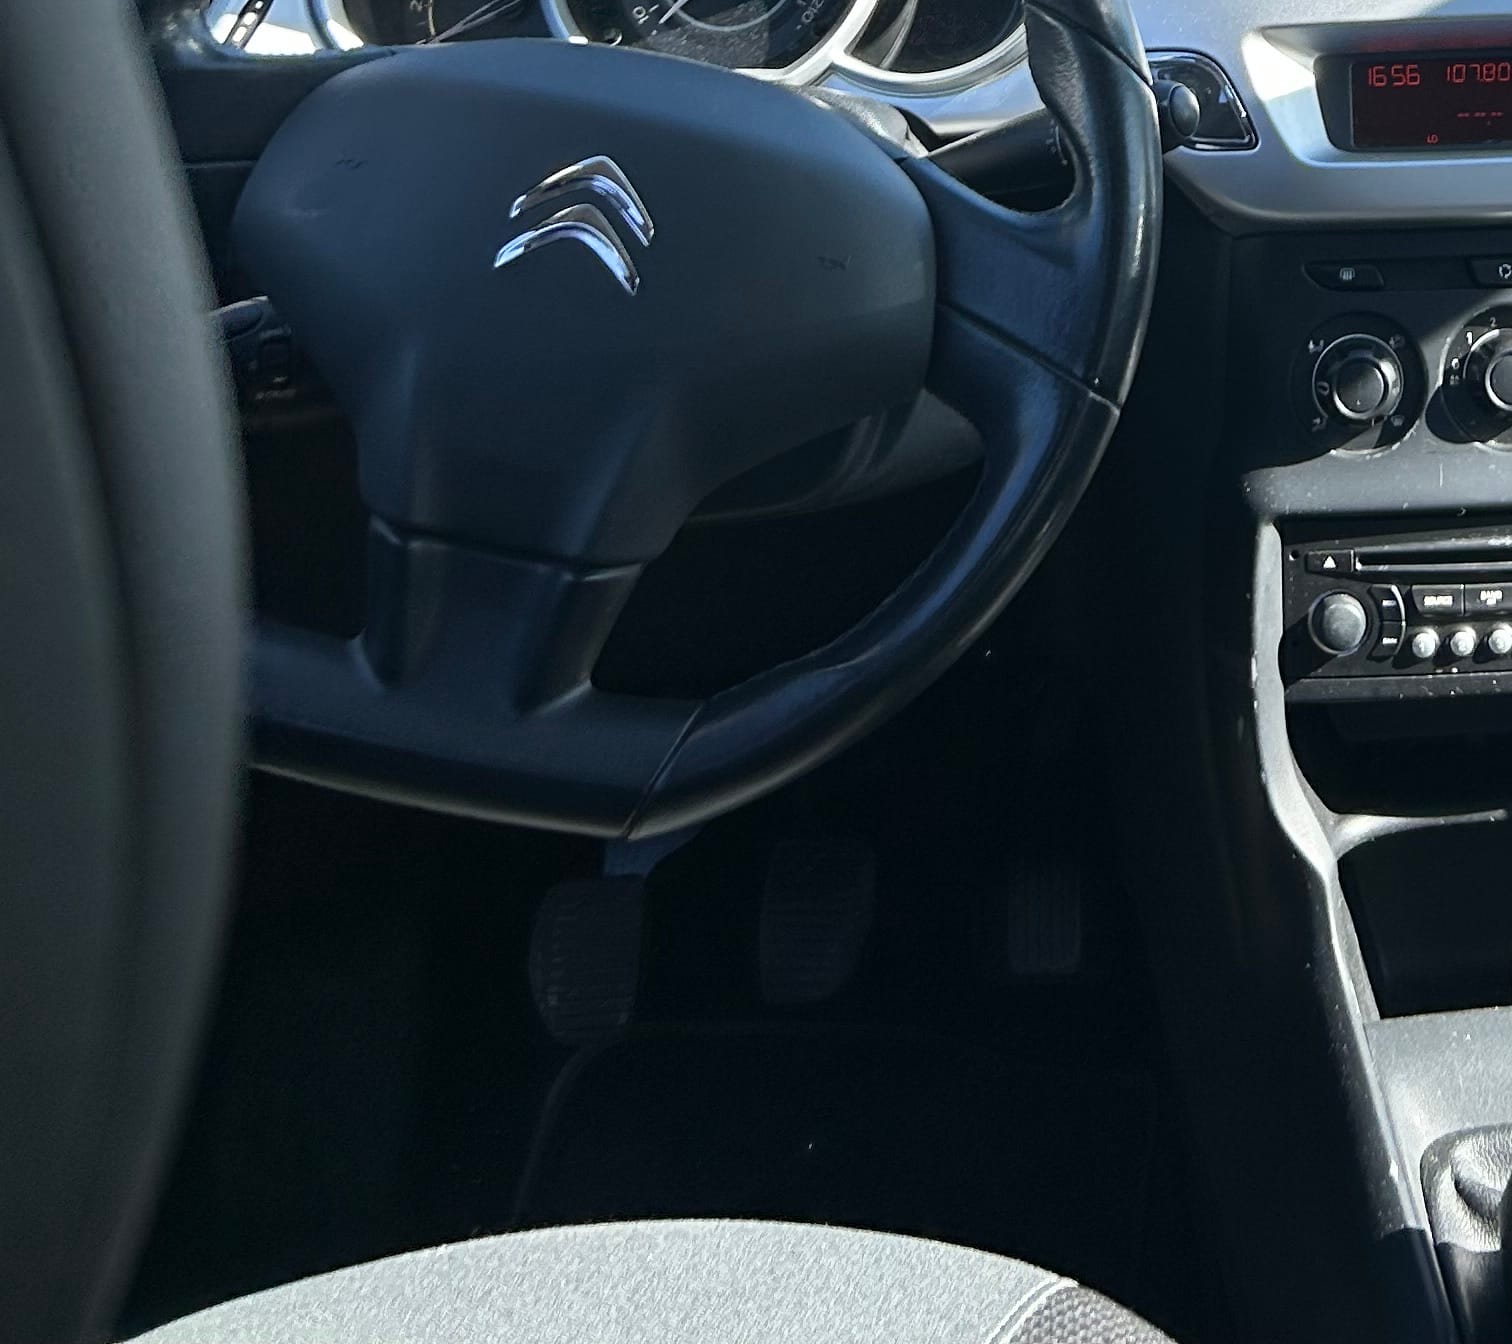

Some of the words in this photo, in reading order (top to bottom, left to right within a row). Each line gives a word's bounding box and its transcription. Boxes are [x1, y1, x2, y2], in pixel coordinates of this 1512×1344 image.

[409, 0, 423, 12] 2
[632, 5, 649, 24] 10
[1490, 316, 1498, 327] 2
[1466, 331, 1473, 346] 1
